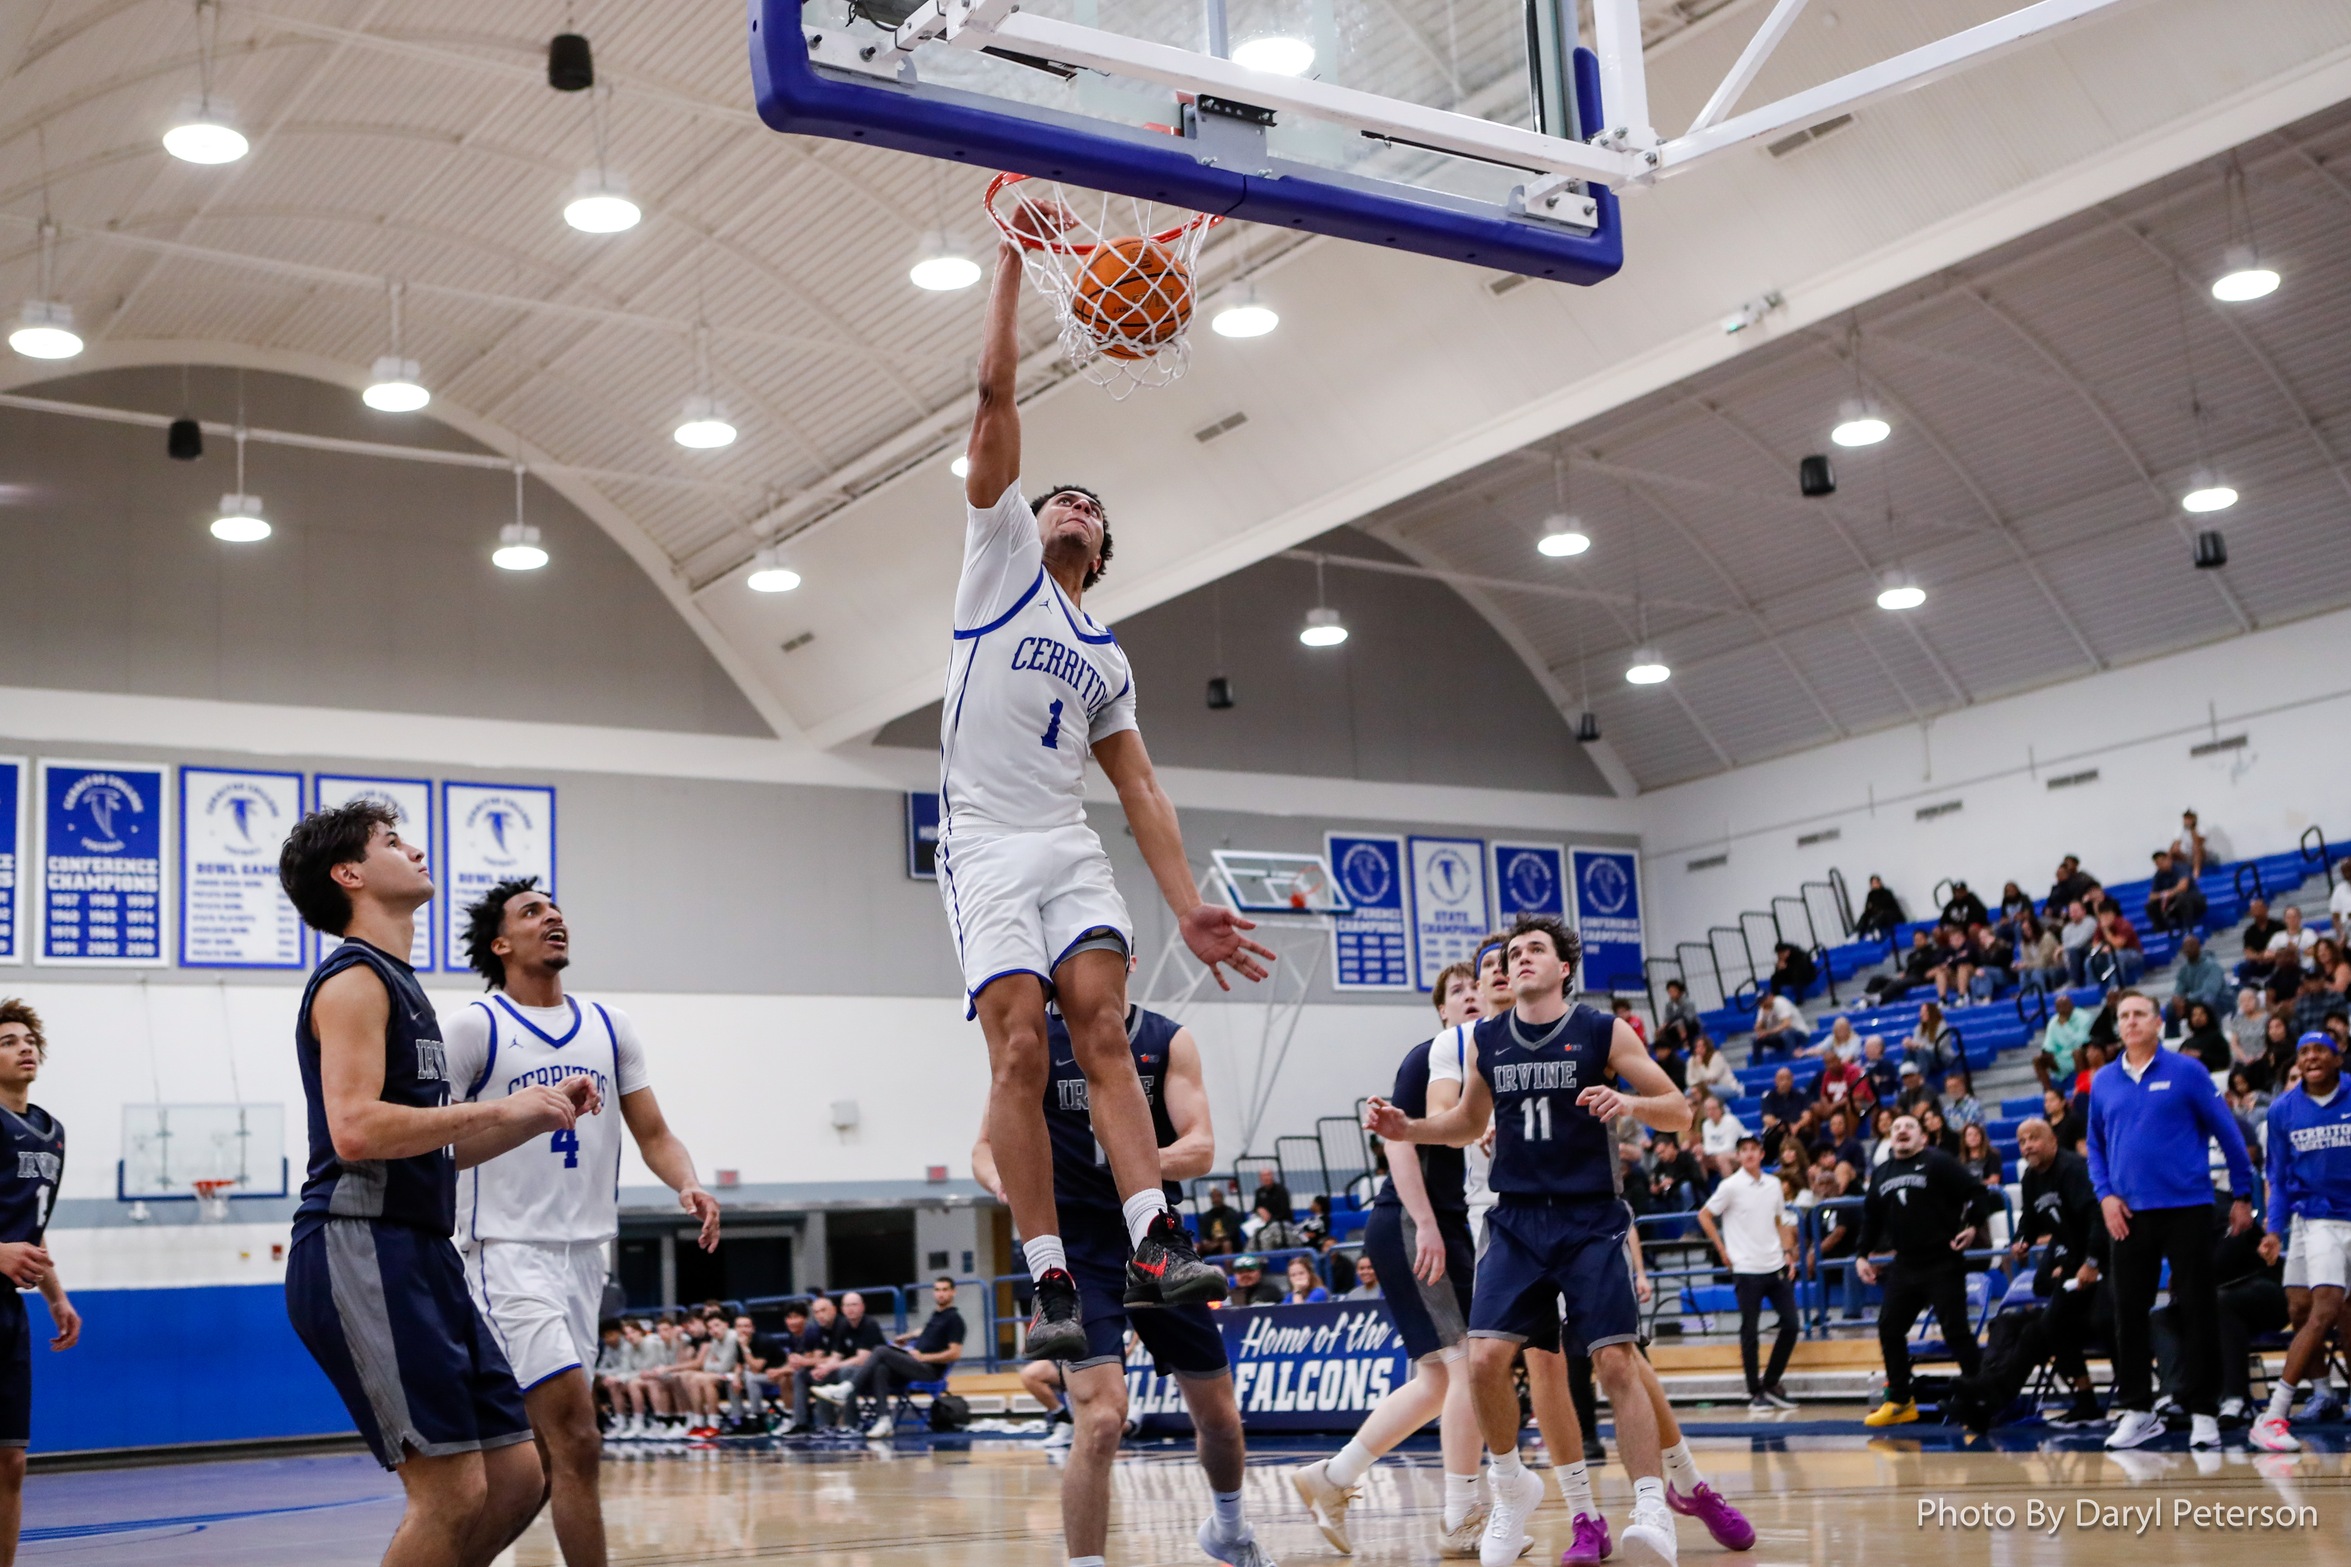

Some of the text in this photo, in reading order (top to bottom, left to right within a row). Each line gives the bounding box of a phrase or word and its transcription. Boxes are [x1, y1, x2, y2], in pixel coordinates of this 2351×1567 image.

[1041, 698, 1064, 750] 1
[47, 855, 158, 875] CONFERENCE
[47, 872, 158, 893] CHAMPIONS
[196, 864, 237, 875] BOWL
[1494, 1061, 1577, 1093] IRVINE
[1521, 1096, 1552, 1141] 11
[550, 1128, 579, 1169] 4
[1239, 1310, 1393, 1359] Home of the
[1235, 1357, 1395, 1412] FALCONS
